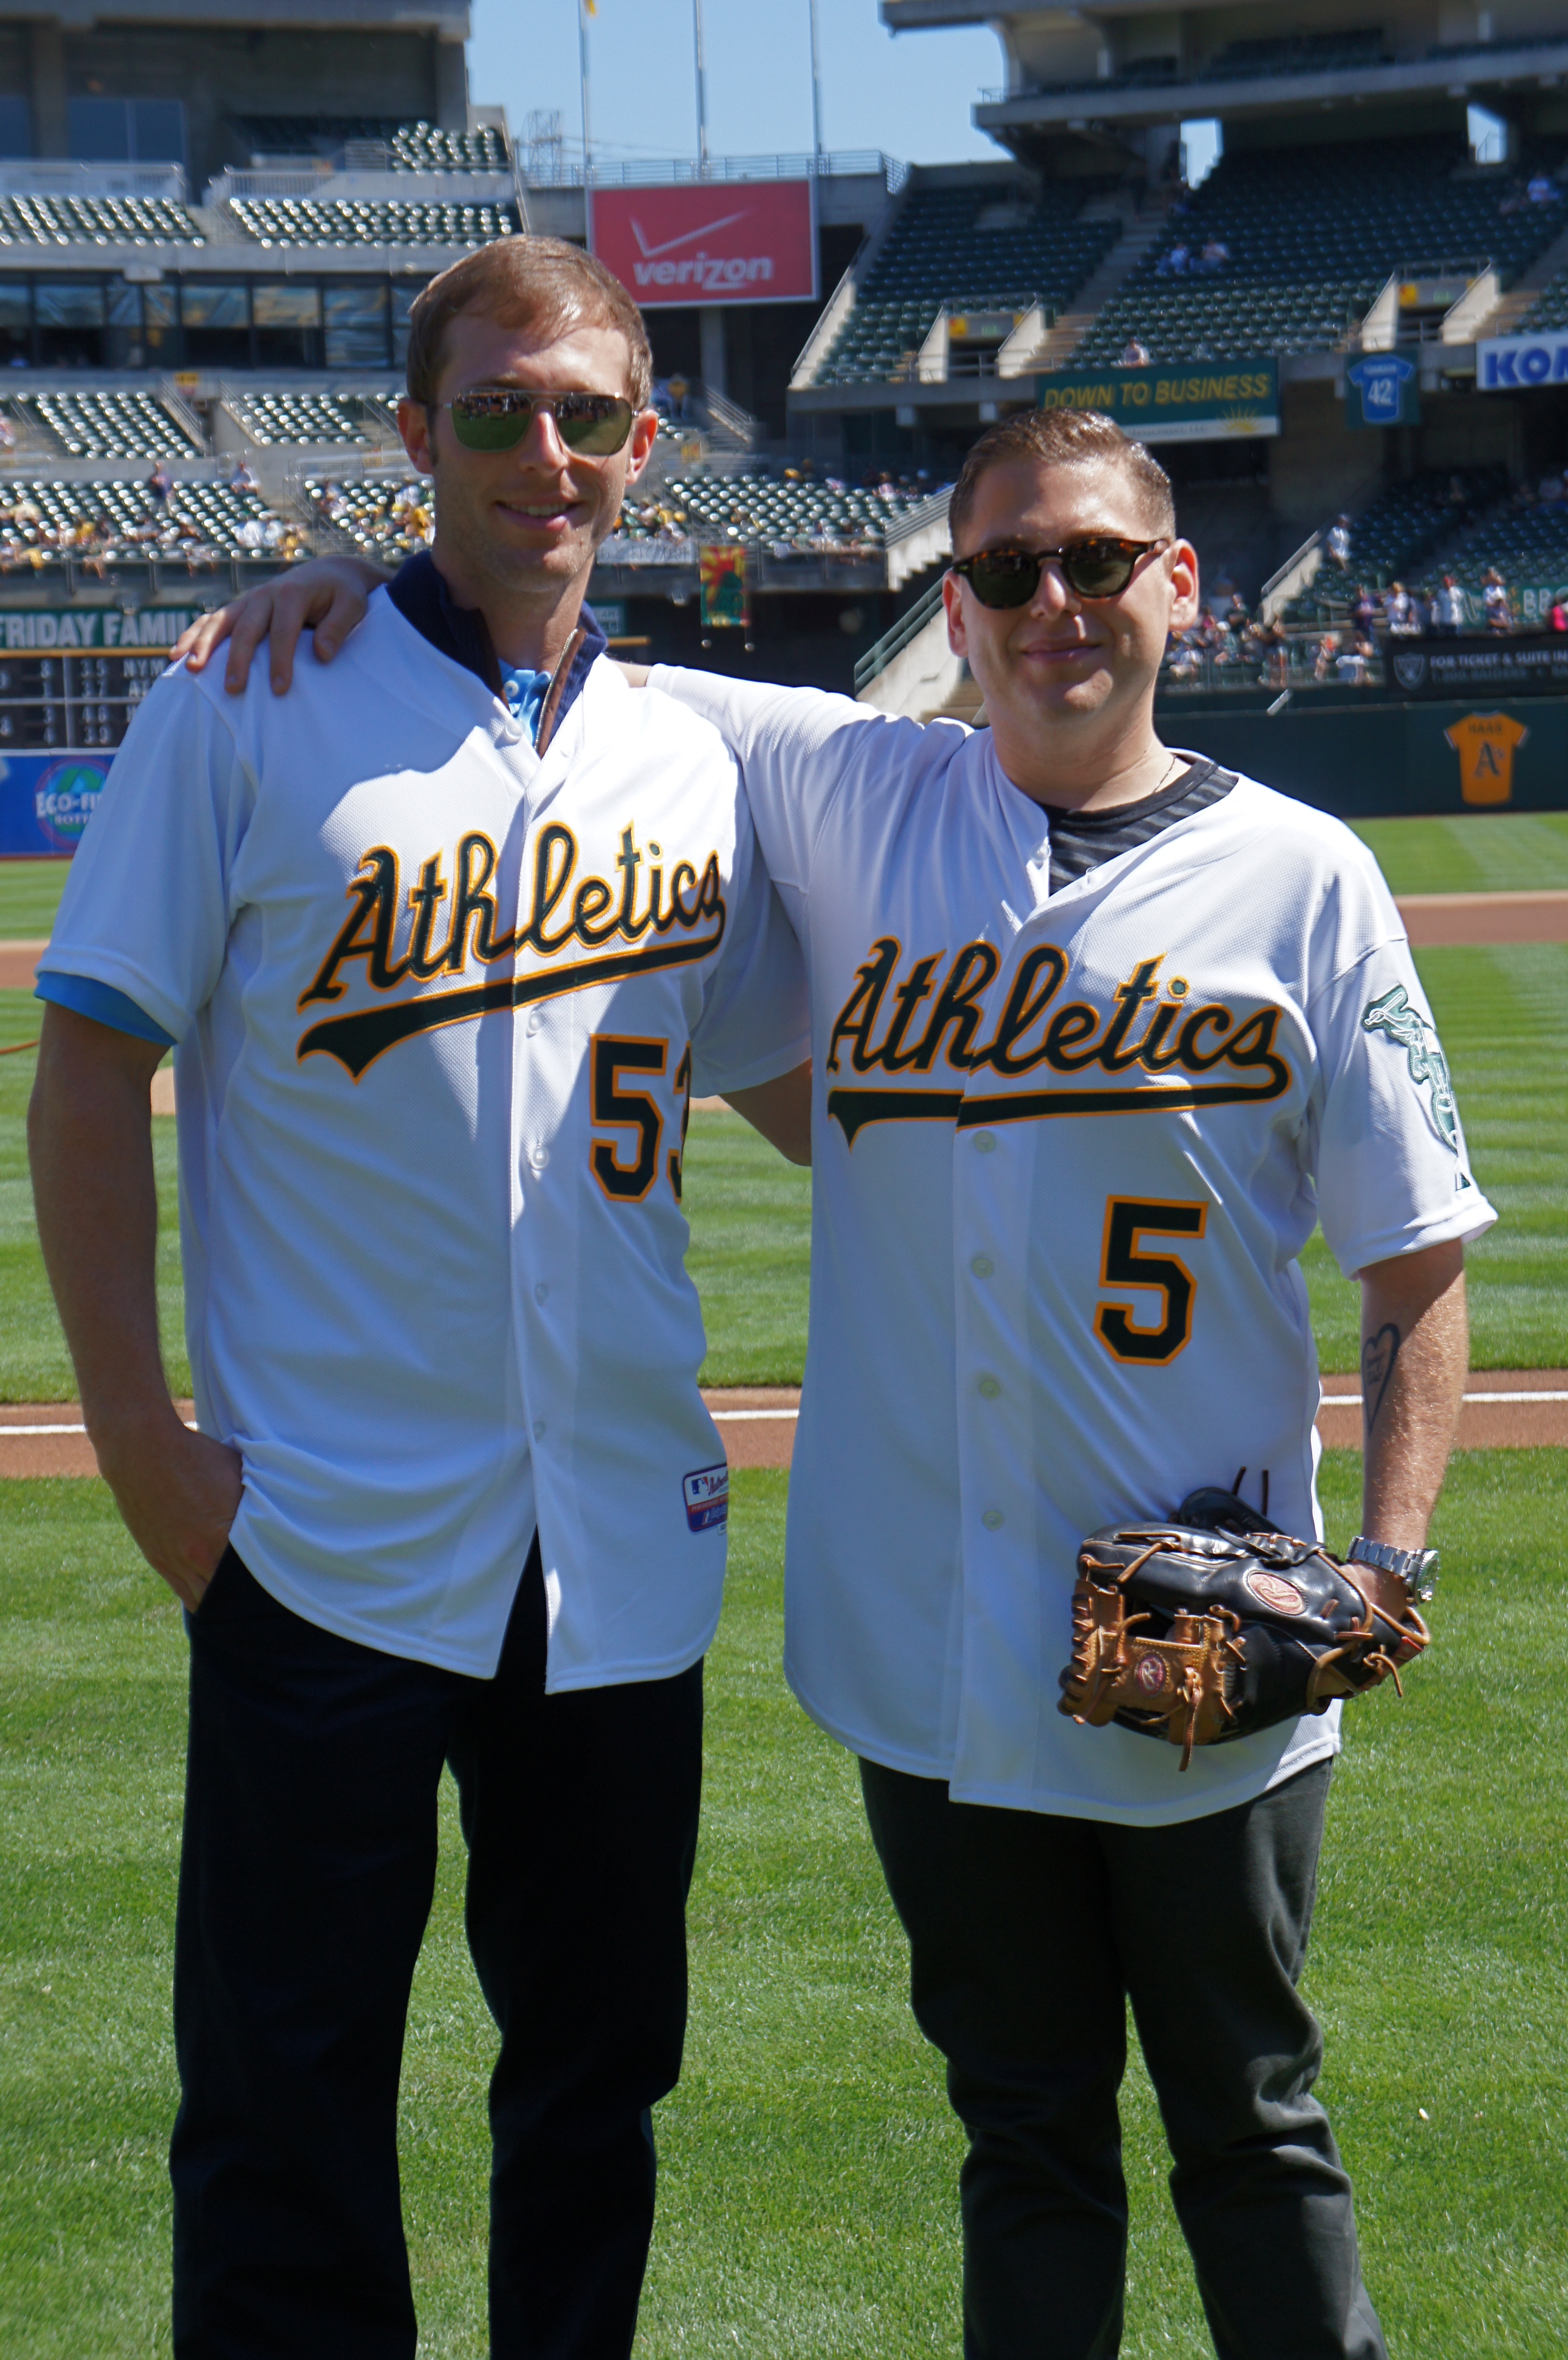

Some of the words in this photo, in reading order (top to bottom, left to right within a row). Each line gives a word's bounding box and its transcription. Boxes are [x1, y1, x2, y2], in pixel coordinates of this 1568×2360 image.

[633, 251, 775, 290] verizon
[1044, 386, 1113, 407] DOWN
[1120, 381, 1149, 406] TO
[1155, 374, 1270, 404] BUSINESS
[1368, 379, 1392, 406] 42
[123, 656, 168, 678] NYM
[1430, 655, 1455, 668] FOR
[1458, 652, 1499, 667] TICKET
[1502, 652, 1512, 666] &
[1515, 650, 1550, 664] SUITE
[296, 819, 726, 1015] Athletics
[827, 935, 1291, 1095] Athletics
[1092, 1194, 1209, 1367] 5
